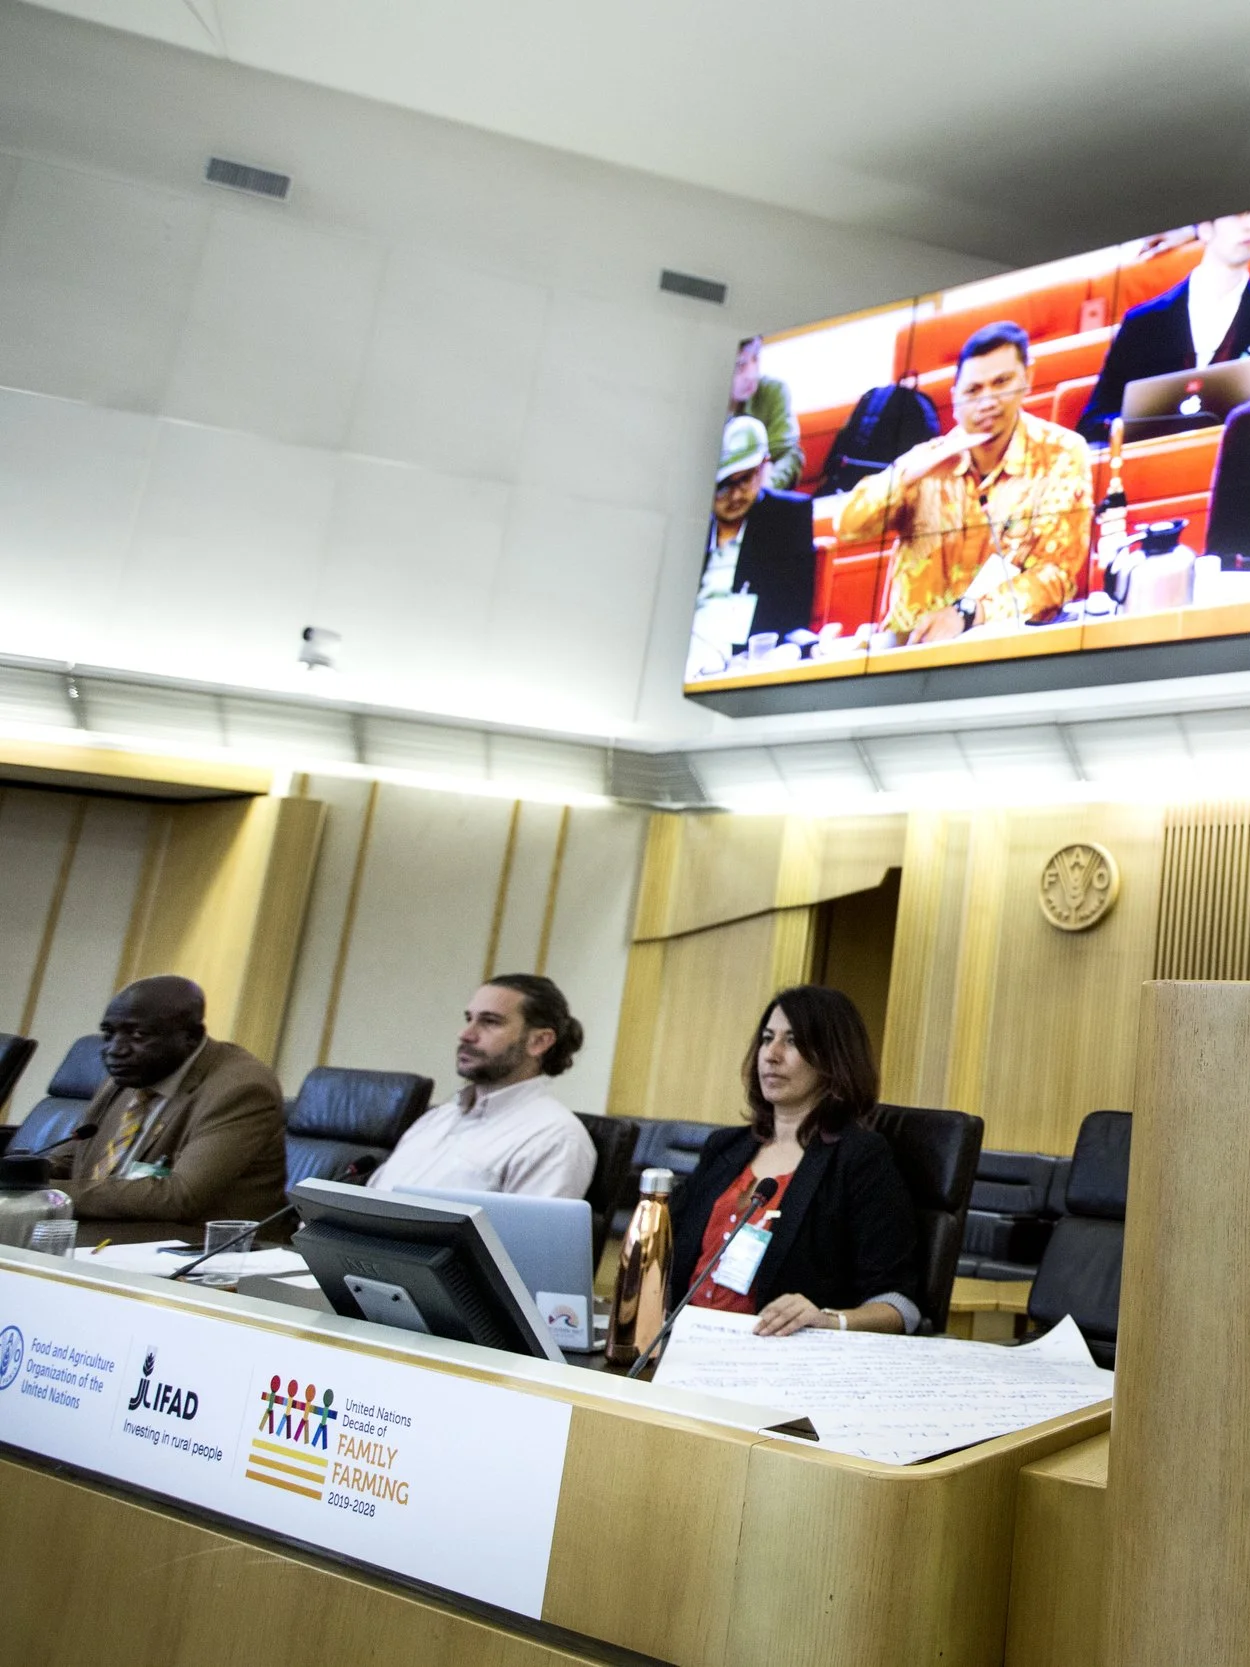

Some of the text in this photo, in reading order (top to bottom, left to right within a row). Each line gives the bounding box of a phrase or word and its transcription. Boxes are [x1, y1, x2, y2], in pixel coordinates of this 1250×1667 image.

[31, 1338, 115, 1373] Food and Agriculture
[26, 1358, 76, 1386] Organization
[79, 1373, 90, 1388] of
[89, 1375, 104, 1393] the
[21, 1379, 80, 1409] United Nations
[153, 1382, 199, 1421] IFAD
[342, 1414, 388, 1438] Decade of
[345, 1398, 412, 1428] United Nations
[123, 1418, 223, 1461] Investing in rural people
[337, 1433, 398, 1470] FAMILY
[332, 1462, 409, 1506] FARMING
[327, 1491, 376, 1517] 2019-2028
